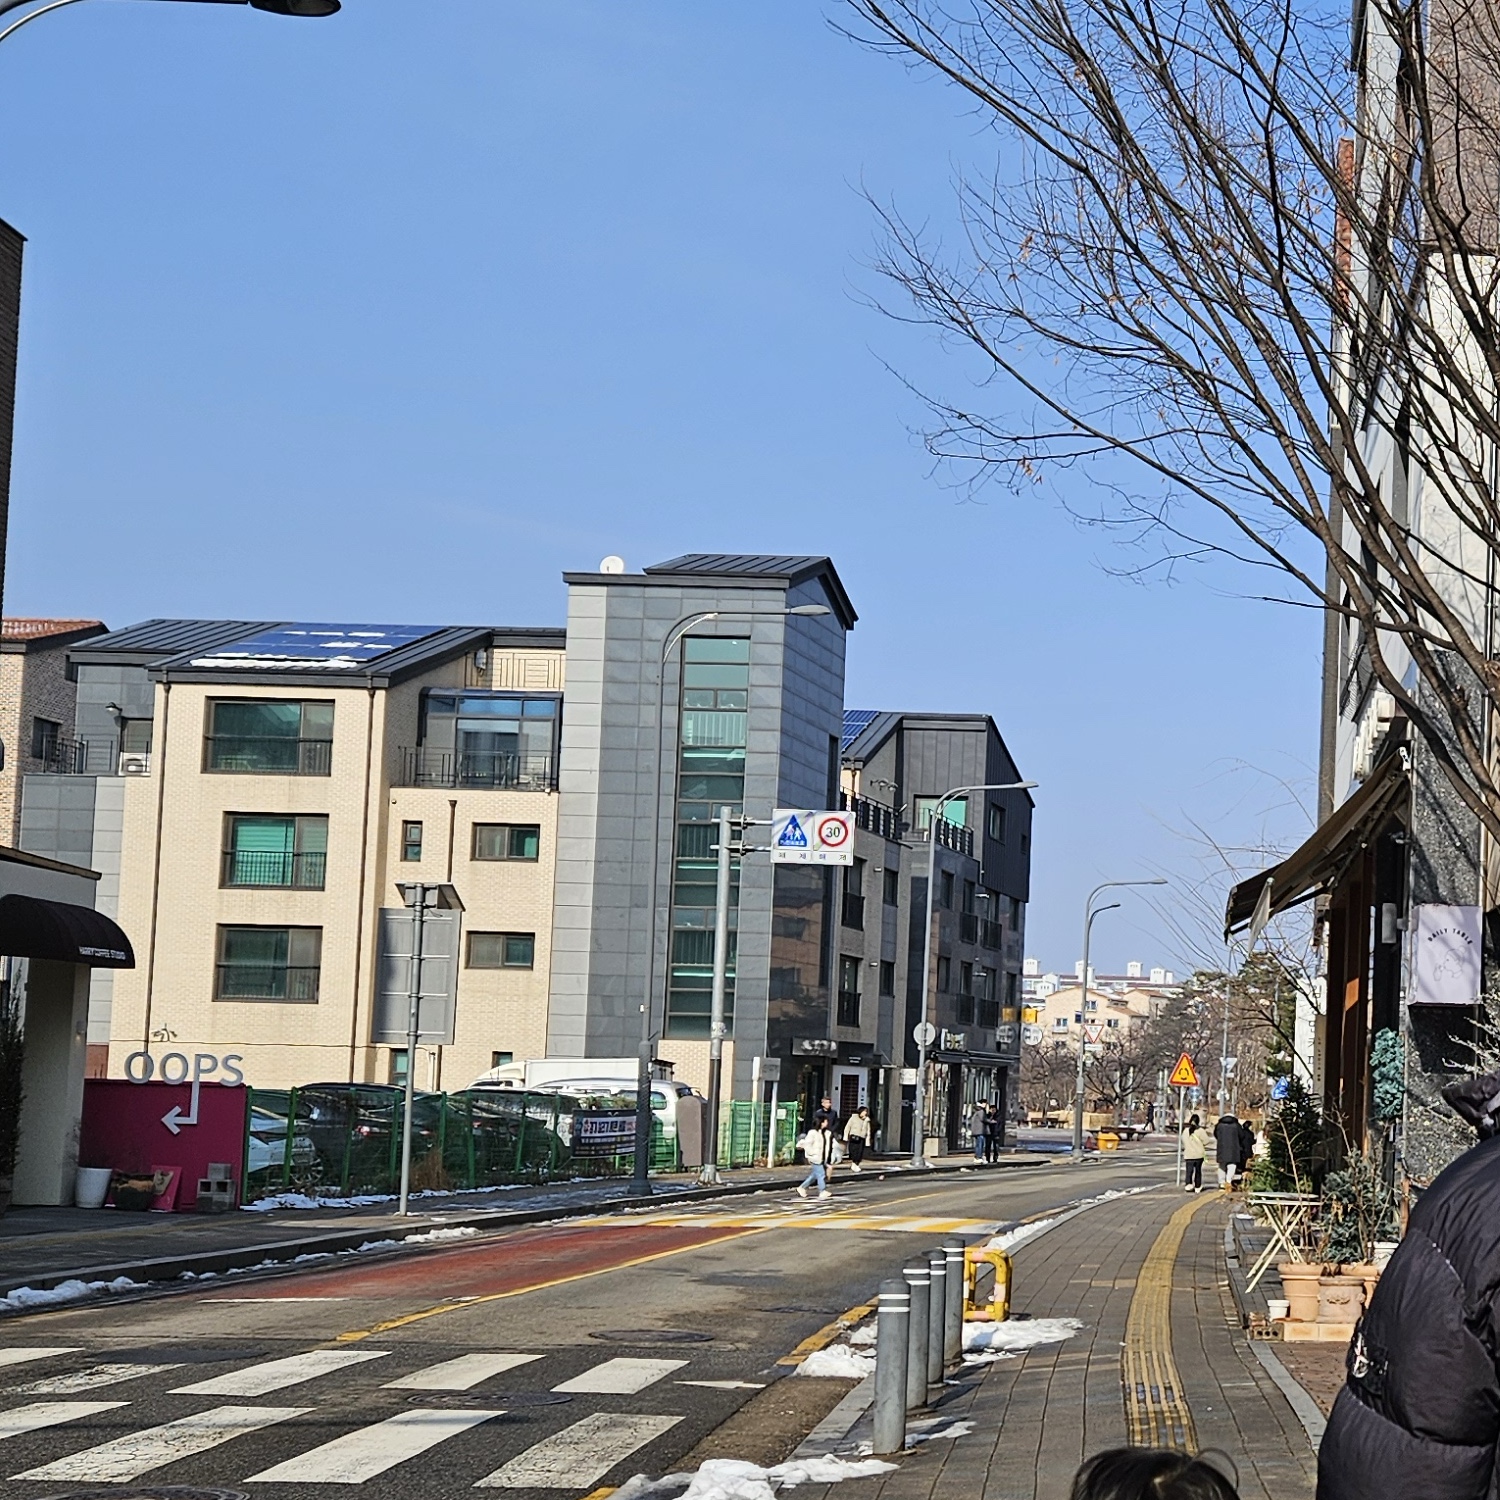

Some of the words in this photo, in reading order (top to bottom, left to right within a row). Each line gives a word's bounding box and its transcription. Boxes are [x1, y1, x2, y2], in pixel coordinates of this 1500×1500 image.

[825, 827, 841, 838] 30
[1427, 928, 1448, 942] DAILY
[1452, 928, 1473, 945] TABLE
[124, 1051, 244, 1087] OOPS
